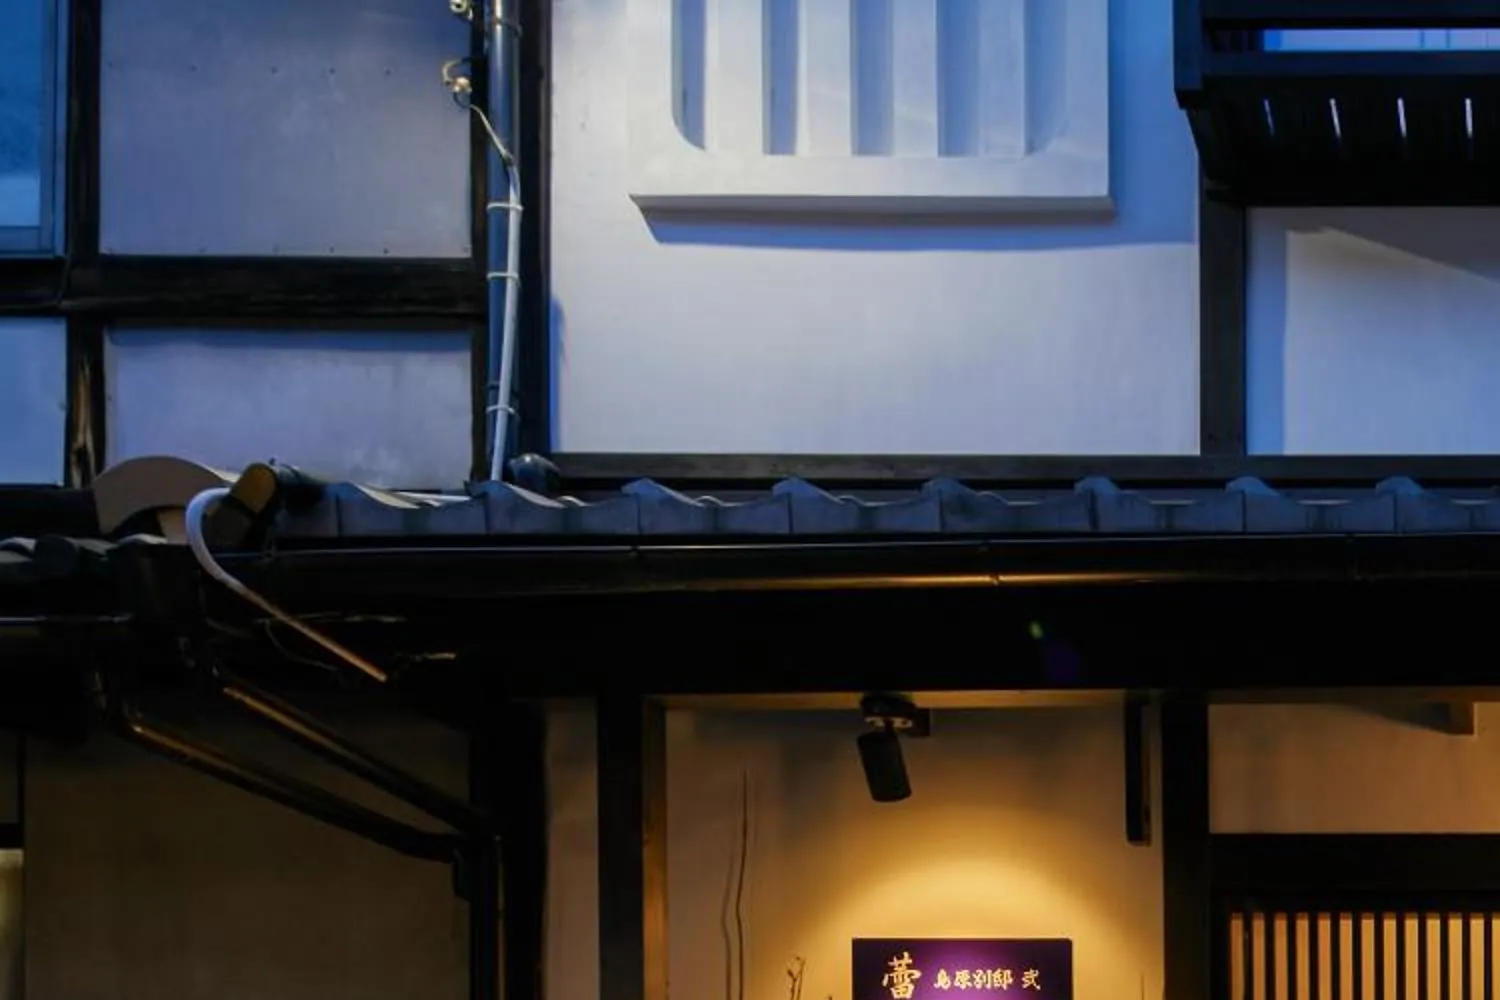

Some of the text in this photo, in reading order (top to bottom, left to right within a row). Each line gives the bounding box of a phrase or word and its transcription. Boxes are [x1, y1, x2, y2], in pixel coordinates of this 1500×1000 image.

[882, 951, 922, 1000] 蕾
[934, 969, 1013, 990] 島原別邸
